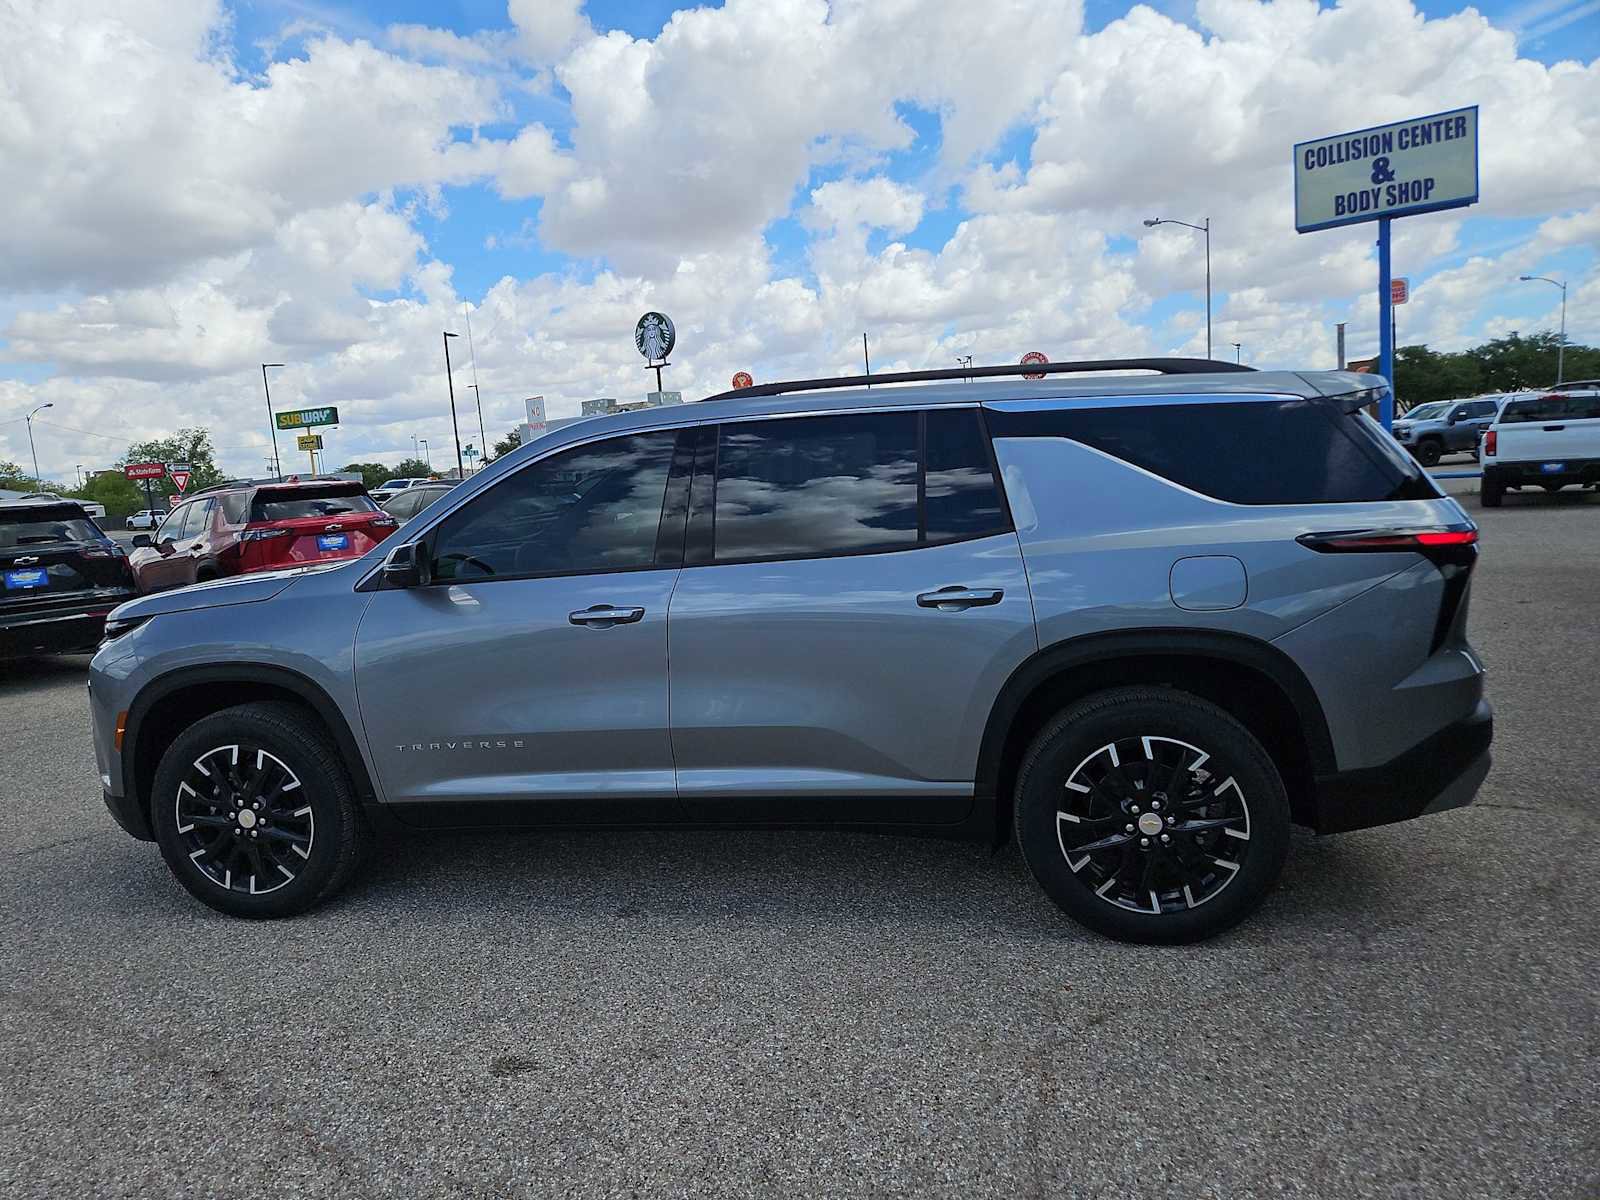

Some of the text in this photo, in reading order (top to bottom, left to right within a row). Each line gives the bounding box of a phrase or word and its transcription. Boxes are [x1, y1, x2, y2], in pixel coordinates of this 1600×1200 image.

[1304, 116, 1467, 170] COLLISION CENTER
[1371, 156, 1395, 184] &
[1335, 178, 1435, 216] BODY SHOP
[279, 410, 328, 426] SUBWAY
[395, 740, 525, 752] TRAVERSE
